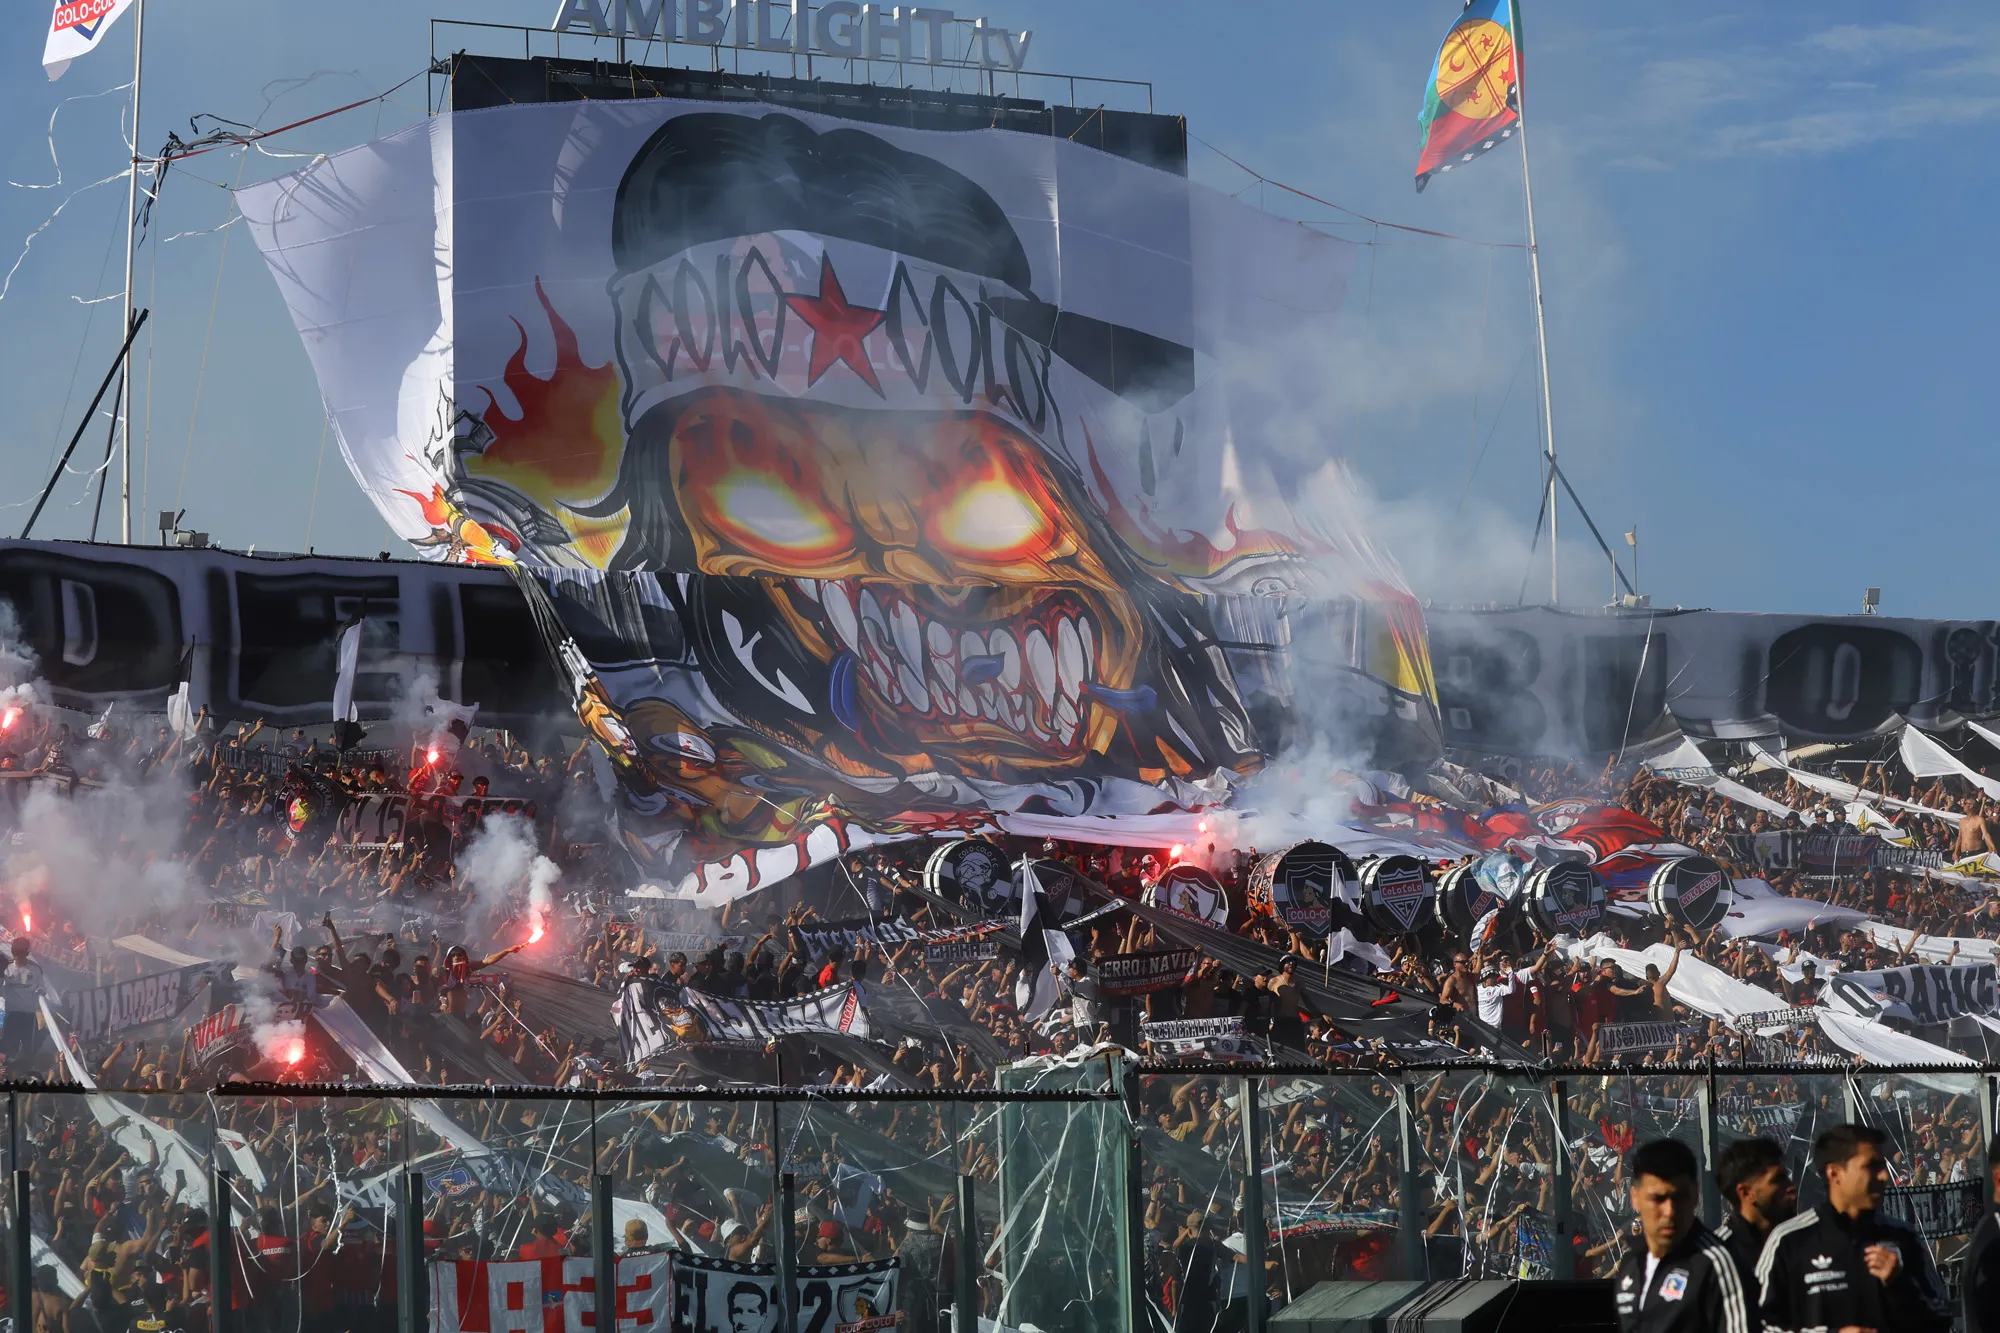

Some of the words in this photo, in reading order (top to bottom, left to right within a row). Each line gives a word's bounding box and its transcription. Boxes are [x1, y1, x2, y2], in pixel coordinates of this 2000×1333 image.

[551, 0, 954, 66] AMBILIGHT
[974, 17, 1033, 70] tv
[634, 246, 787, 381] COLO
[885, 260, 1046, 433] COLO
[1290, 908, 1332, 920] COLO-CO
[799, 914, 920, 963] ETERNOS
[1098, 958, 1139, 978] CERRO
[1149, 951, 1196, 974] NAVIA
[69, 970, 181, 1040] ZAPADORES
[1738, 1014, 1753, 1025] OS
[1767, 1007, 1814, 1022] ANGELES
[1157, 1018, 1217, 1039] ESMERALDA
[1602, 1028, 1622, 1050] LOS
[1633, 1024, 1675, 1047] ANDES
[1719, 1095, 1752, 1115] RAZO
[339, 1176, 396, 1208] SA
